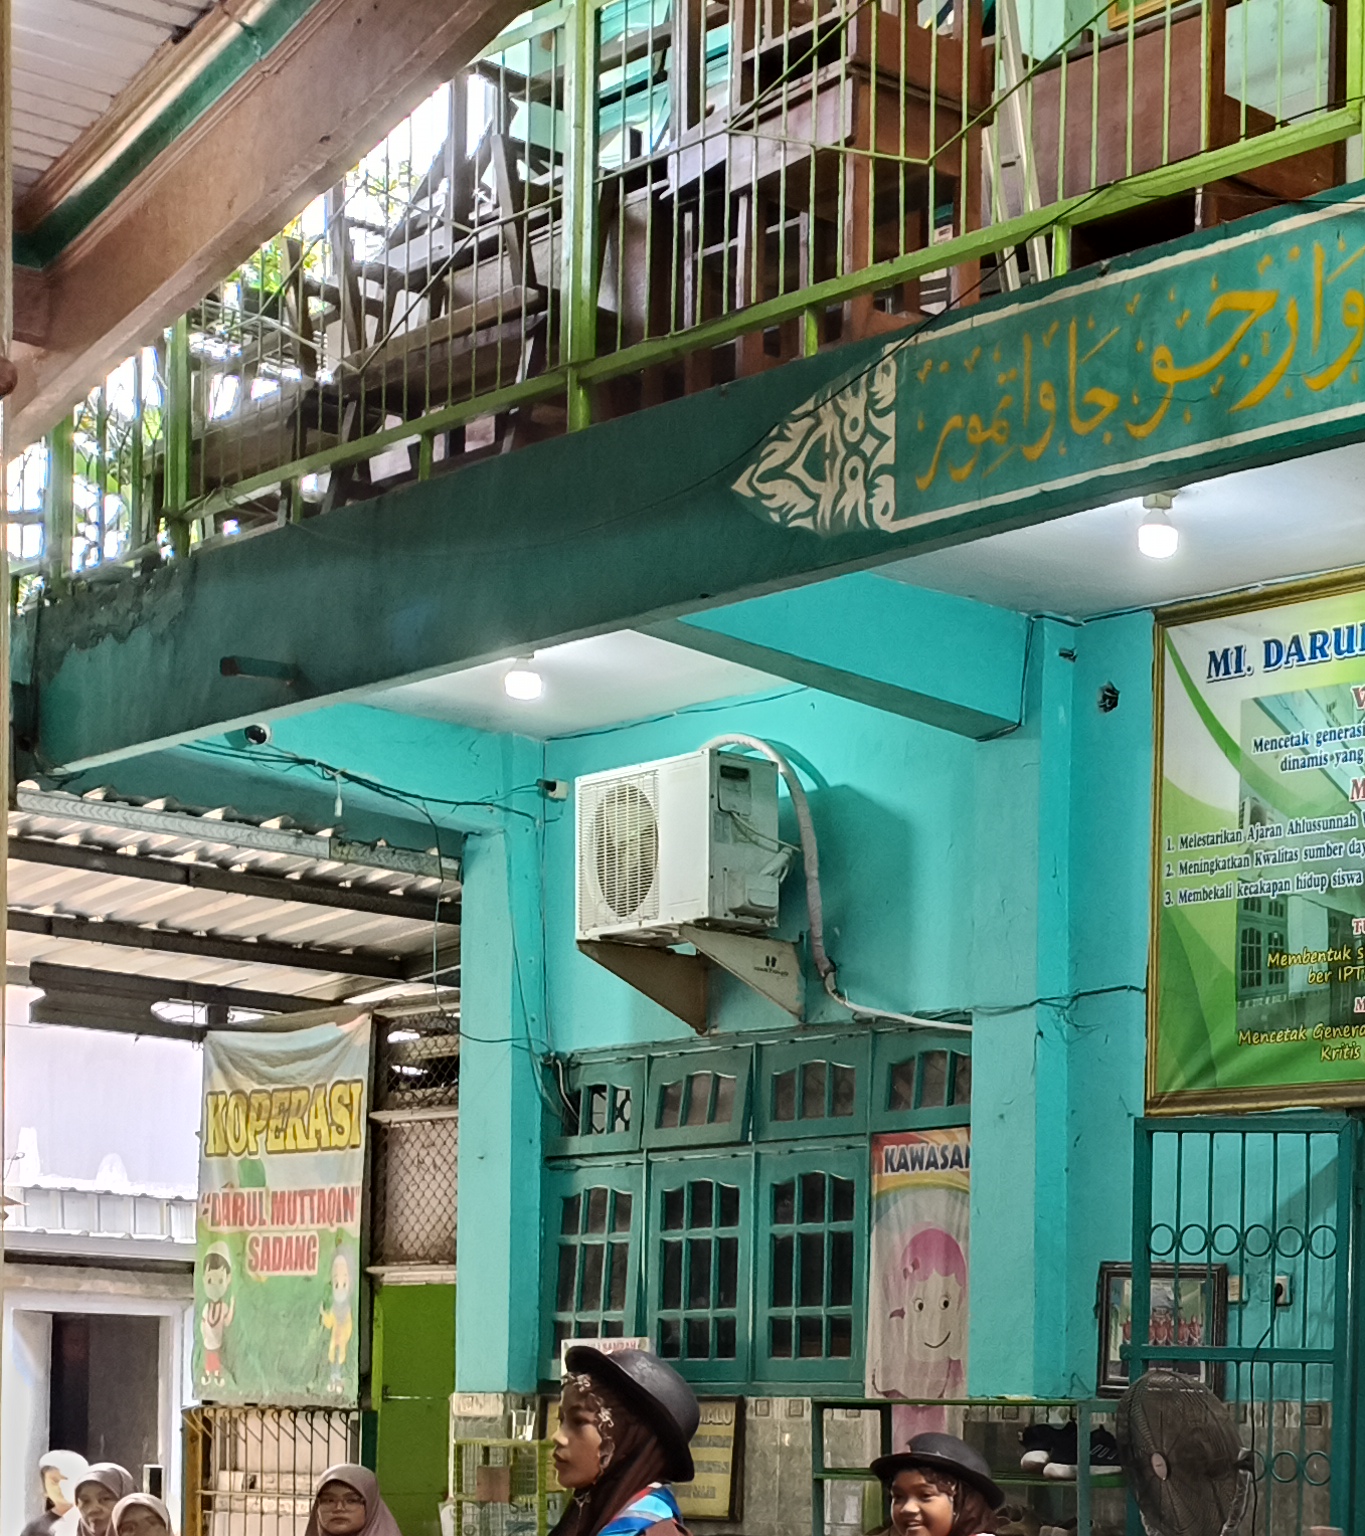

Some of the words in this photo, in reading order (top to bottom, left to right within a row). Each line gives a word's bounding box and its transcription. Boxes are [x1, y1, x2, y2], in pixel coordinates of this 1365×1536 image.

[1206, 644, 1253, 683] MI.
[1252, 732, 1310, 753] Mencetak
[1315, 722, 1365, 747] generasi
[1280, 752, 1329, 774] dinamis
[1333, 748, 1364, 769] yang
[1179, 828, 1242, 850] Melestarikan
[1247, 824, 1283, 843] Ajaran
[1287, 813, 1357, 836] Ahlussunnah
[1178, 854, 1250, 878] Meningkatkan
[1254, 847, 1299, 866] Kwalitas
[1303, 842, 1344, 861] sumber
[1178, 884, 1233, 905] Membekali
[1237, 877, 1291, 899] kecakapan
[1296, 871, 1328, 893] hidup
[1332, 868, 1362, 887] siswa
[1267, 943, 1352, 968] Membentuk
[1307, 967, 1332, 985] ber
[1238, 1023, 1307, 1046] Mencetak
[1320, 1041, 1361, 1062] Kritis
[205, 1079, 364, 1157] KOPERASI
[246, 1233, 319, 1275] SADANG
